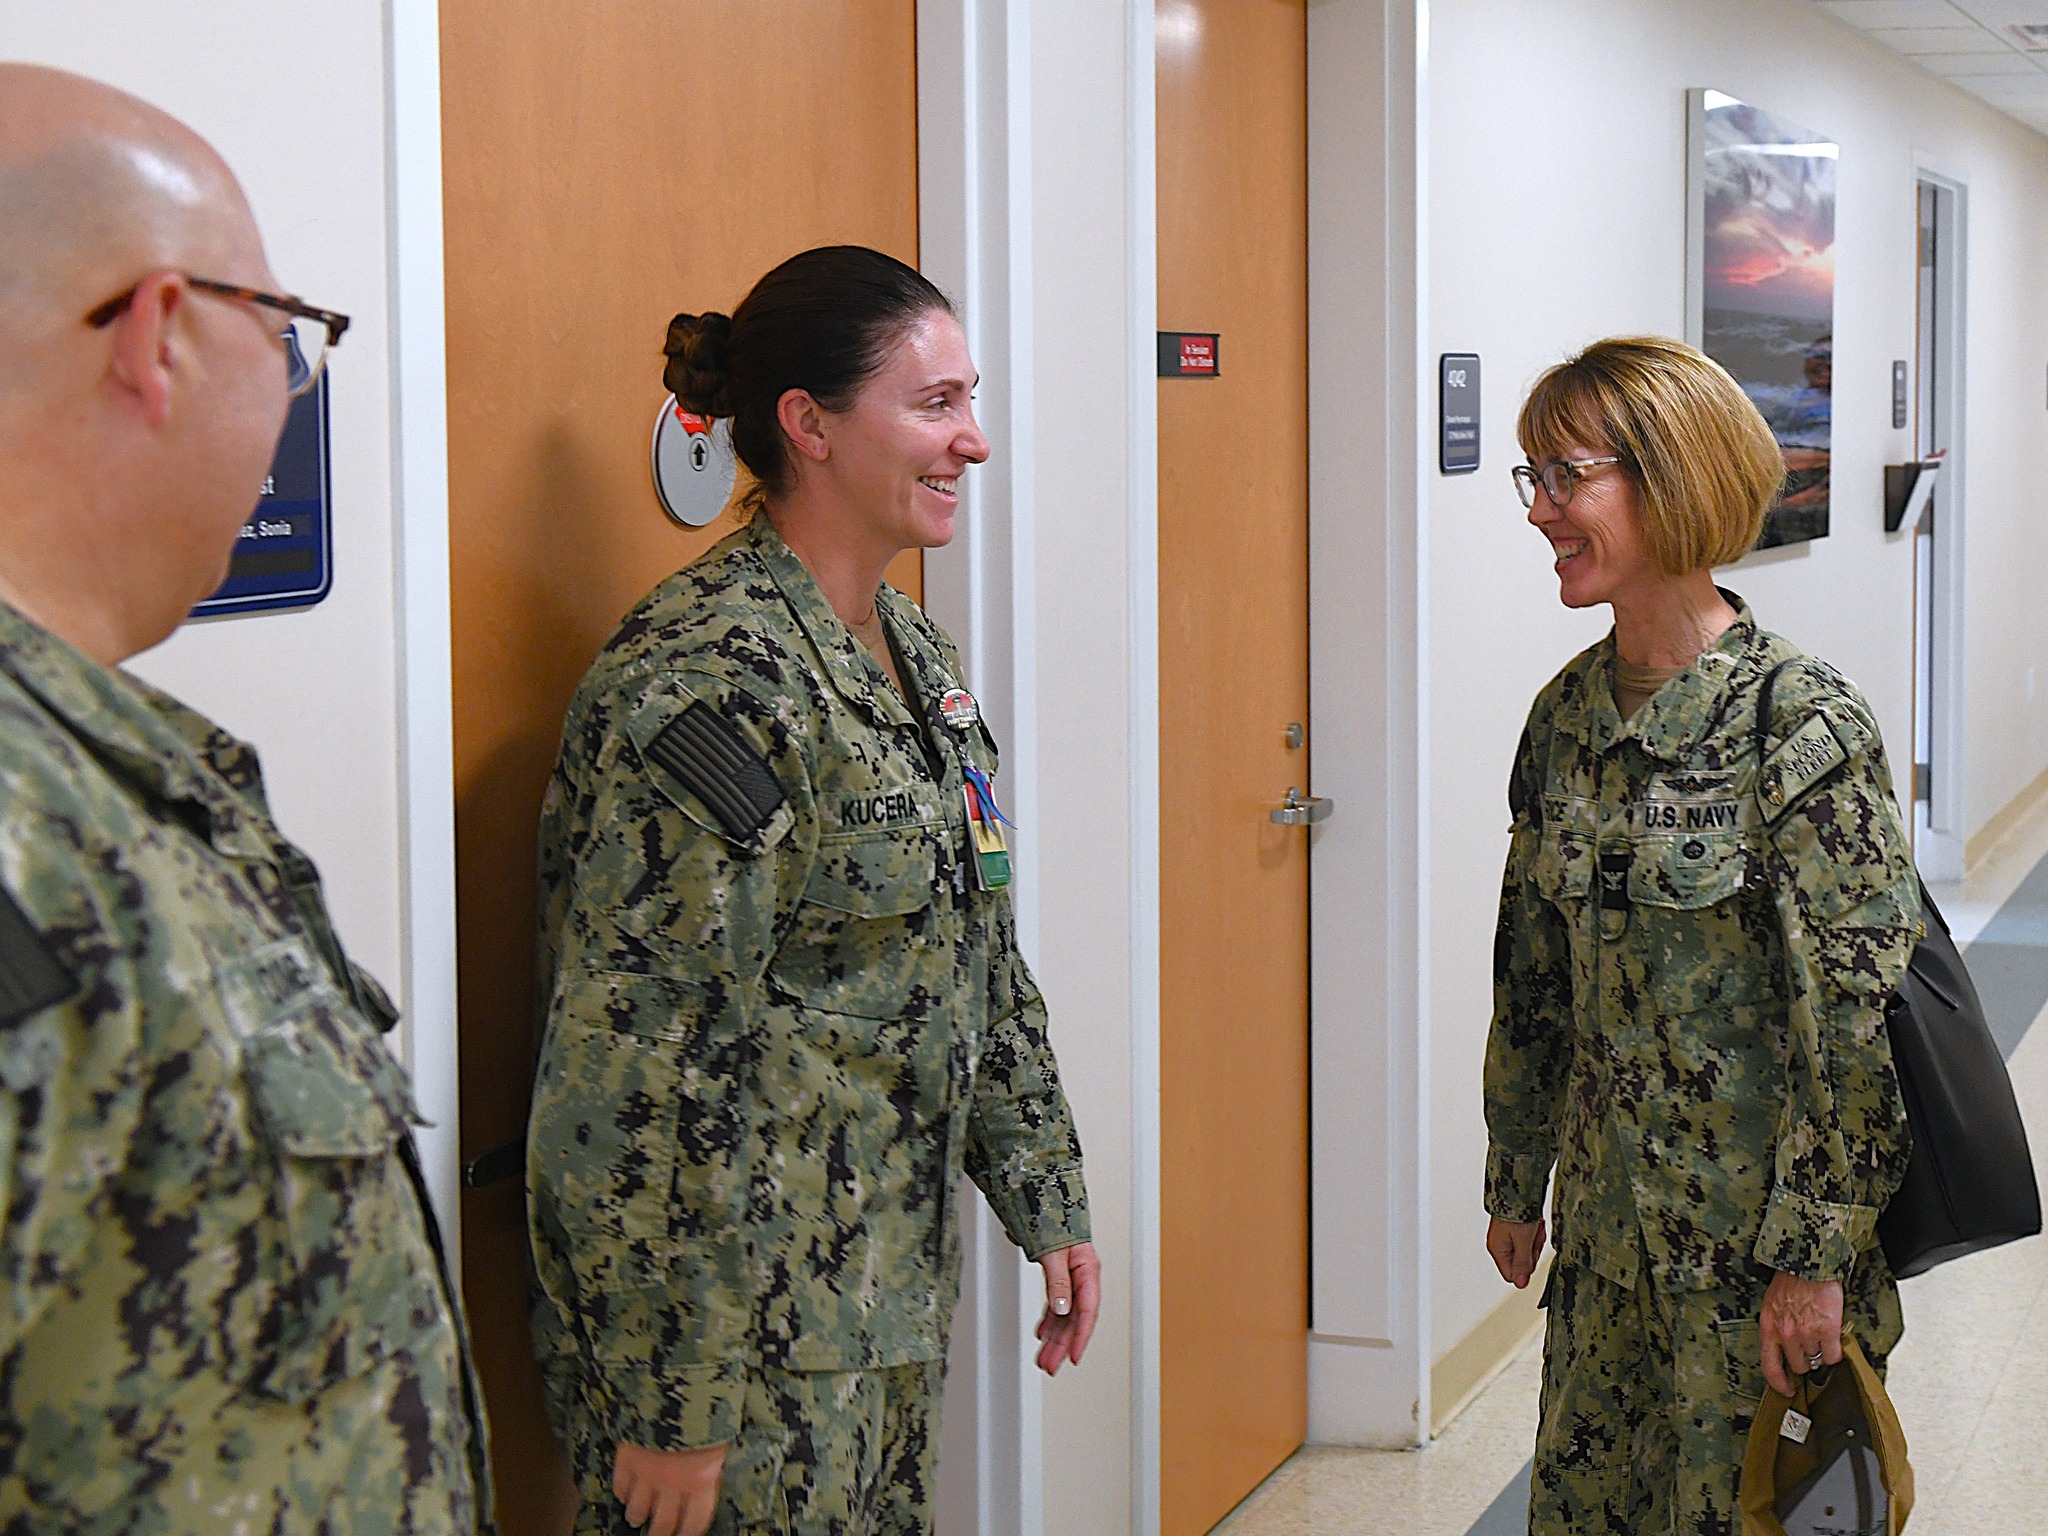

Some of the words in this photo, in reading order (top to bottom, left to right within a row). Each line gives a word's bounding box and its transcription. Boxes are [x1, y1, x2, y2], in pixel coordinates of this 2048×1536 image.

[259, 520, 292, 537] Sonia
[1785, 734, 1831, 775] SECOND
[1797, 749, 1833, 780] FLEET
[841, 792, 919, 826] KUCERA
[1645, 805, 1681, 828] U.S.
[1687, 804, 1738, 828] NAVY
